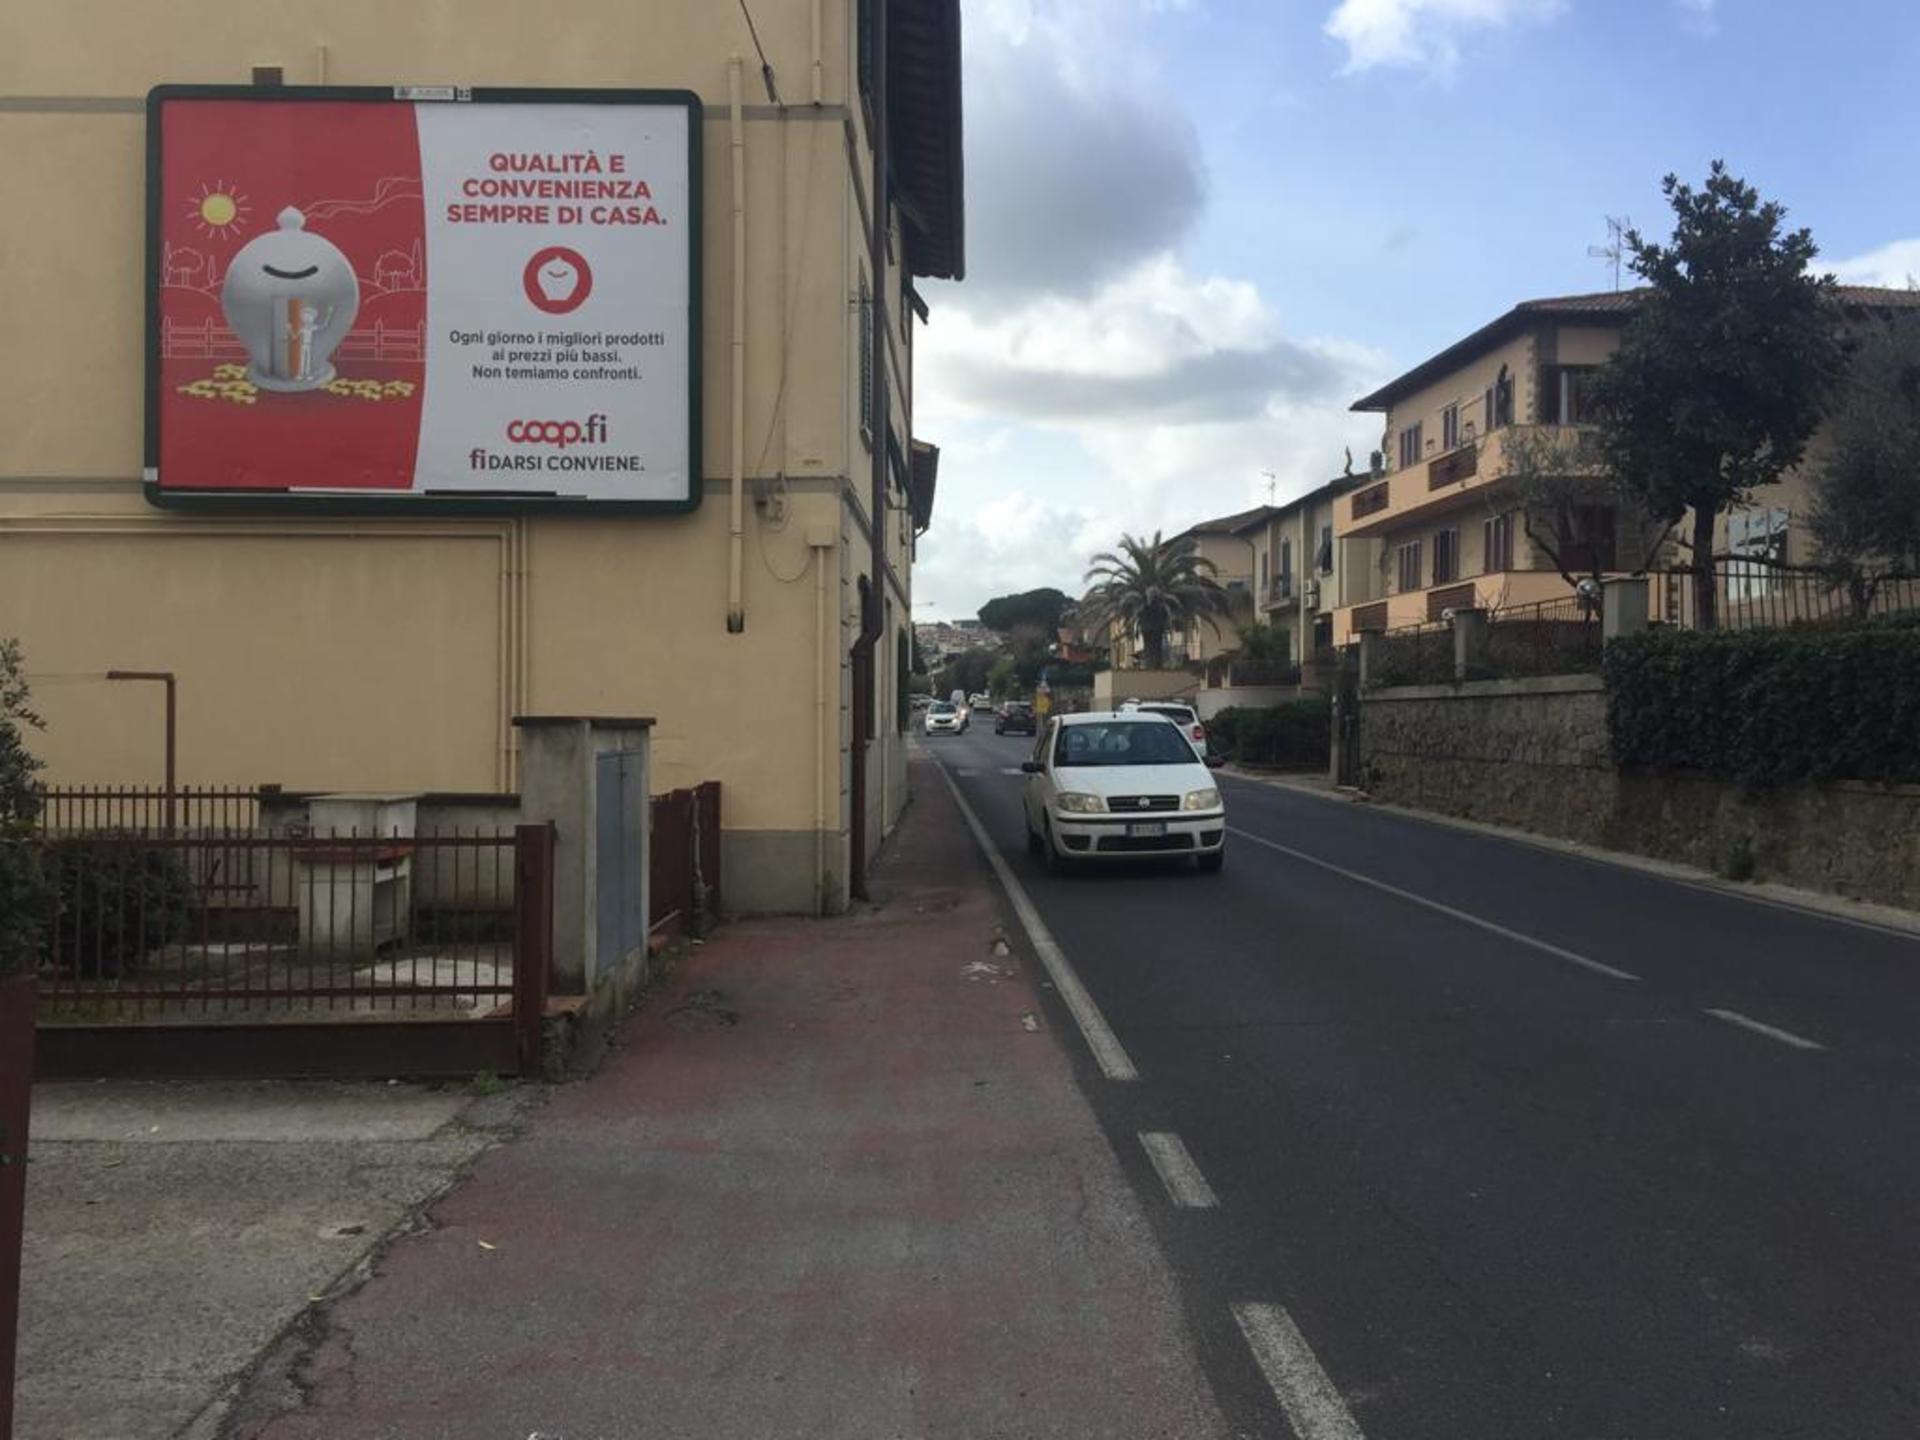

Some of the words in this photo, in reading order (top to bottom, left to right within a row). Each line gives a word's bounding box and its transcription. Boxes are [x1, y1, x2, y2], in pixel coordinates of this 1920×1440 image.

[489, 150, 602, 173] QUALITÀ
[609, 155, 625, 173] E
[462, 178, 652, 200] CONVENIENZA
[447, 204, 549, 224] SEMPRE
[557, 206, 583, 225] DI
[590, 206, 667, 226] CASA.
[449, 330, 484, 346] Ogni
[487, 332, 535, 346] giorno
[537, 332, 543, 344] i
[546, 331, 602, 347] migliori
[605, 332, 665, 347] prodotti
[491, 350, 505, 361] ai
[508, 350, 552, 363] prezzi
[556, 350, 579, 363] più
[582, 350, 622, 363] bassi.
[472, 365, 502, 379] Non
[505, 366, 570, 380] temiamo
[573, 367, 643, 380] confronti.
[507, 413, 607, 449] coop.fi
[546, 455, 645, 472] CONVIENE.
